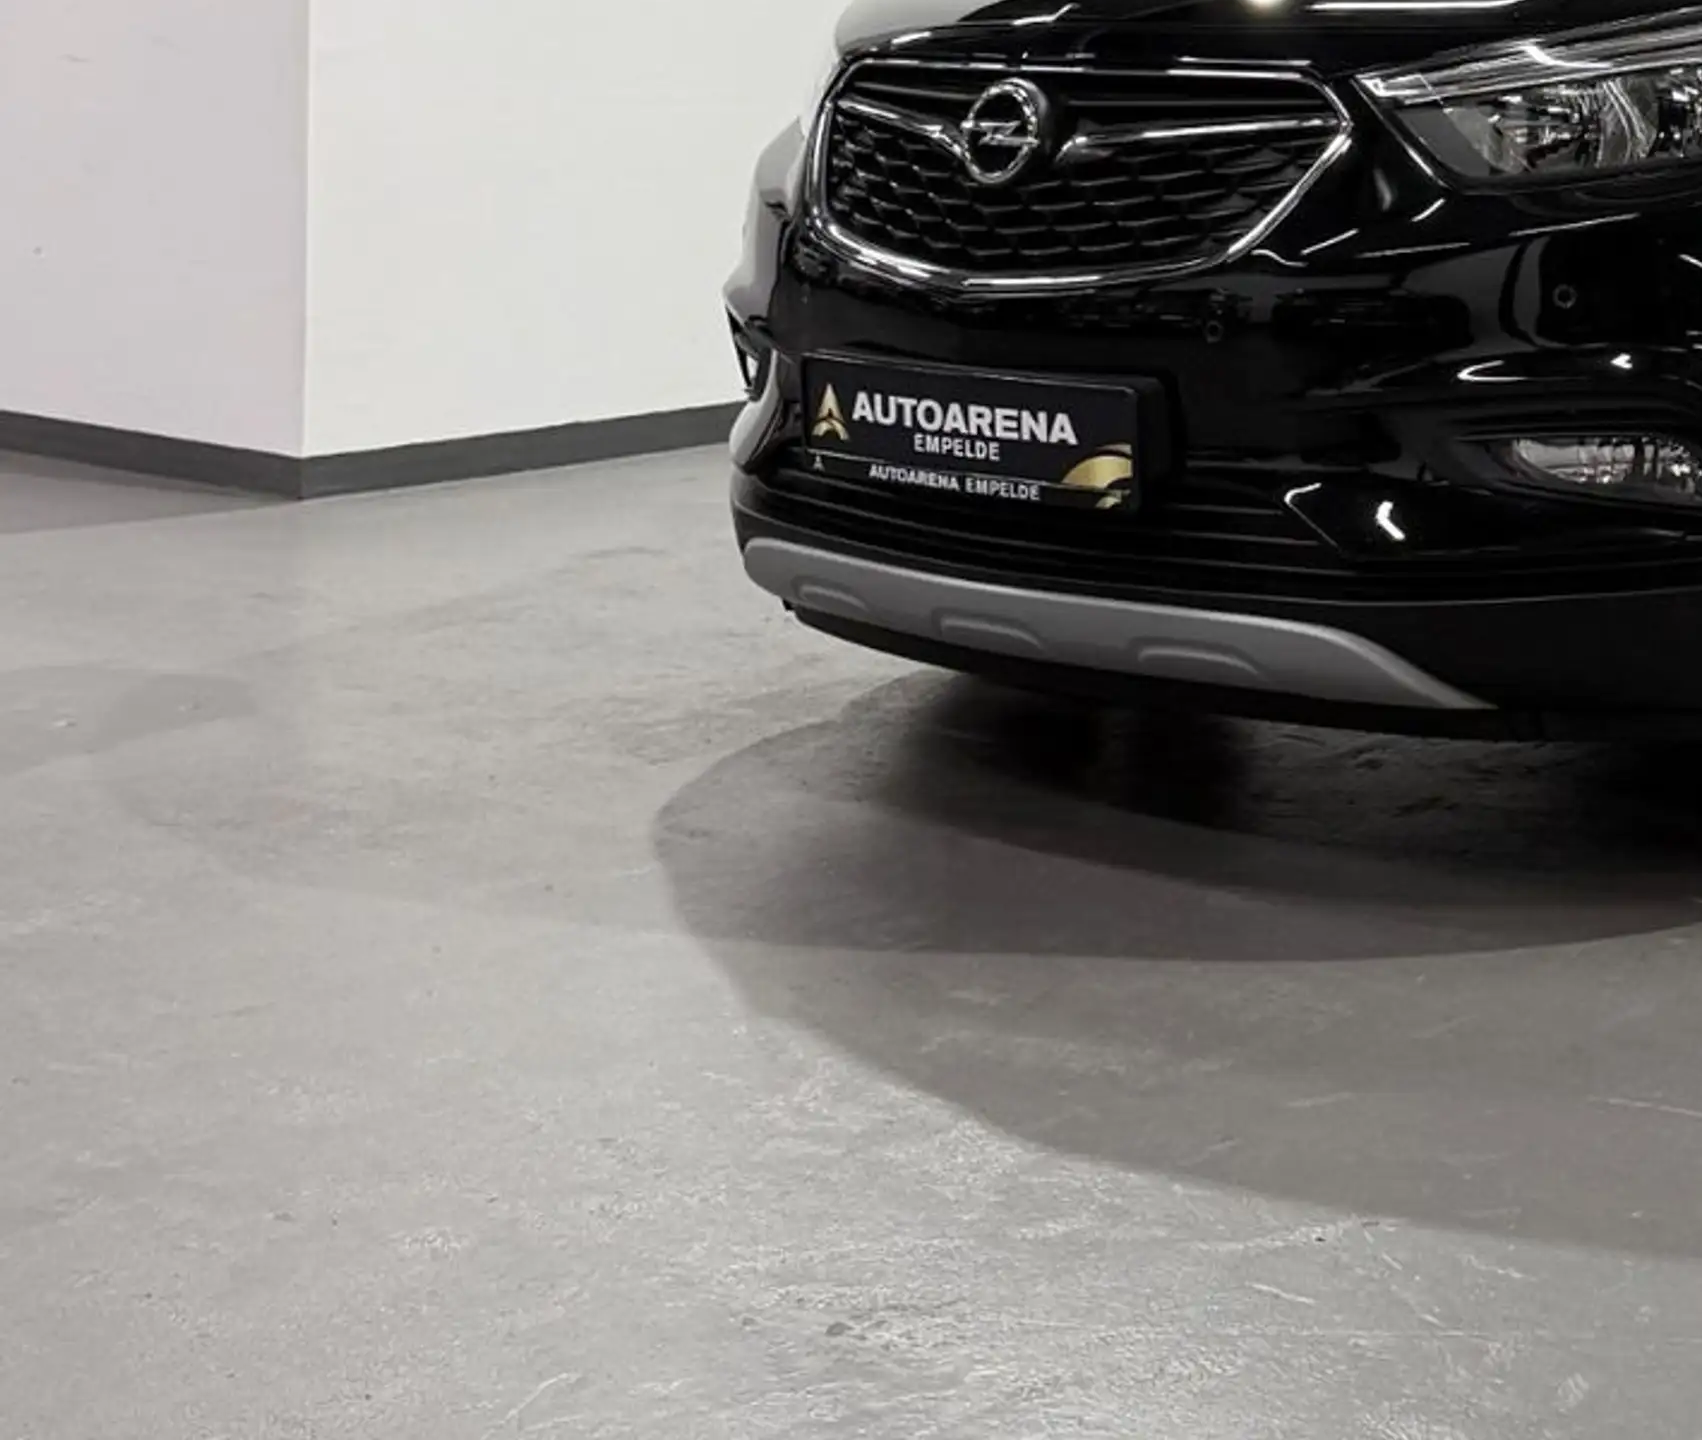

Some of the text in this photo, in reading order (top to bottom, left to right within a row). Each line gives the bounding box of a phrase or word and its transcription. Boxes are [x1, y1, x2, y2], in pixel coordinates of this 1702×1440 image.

[851, 391, 1078, 446] AUTOARENA
[913, 433, 1001, 462] EMPELDE
[868, 463, 1040, 501] AUTOARENA EMPELDE
